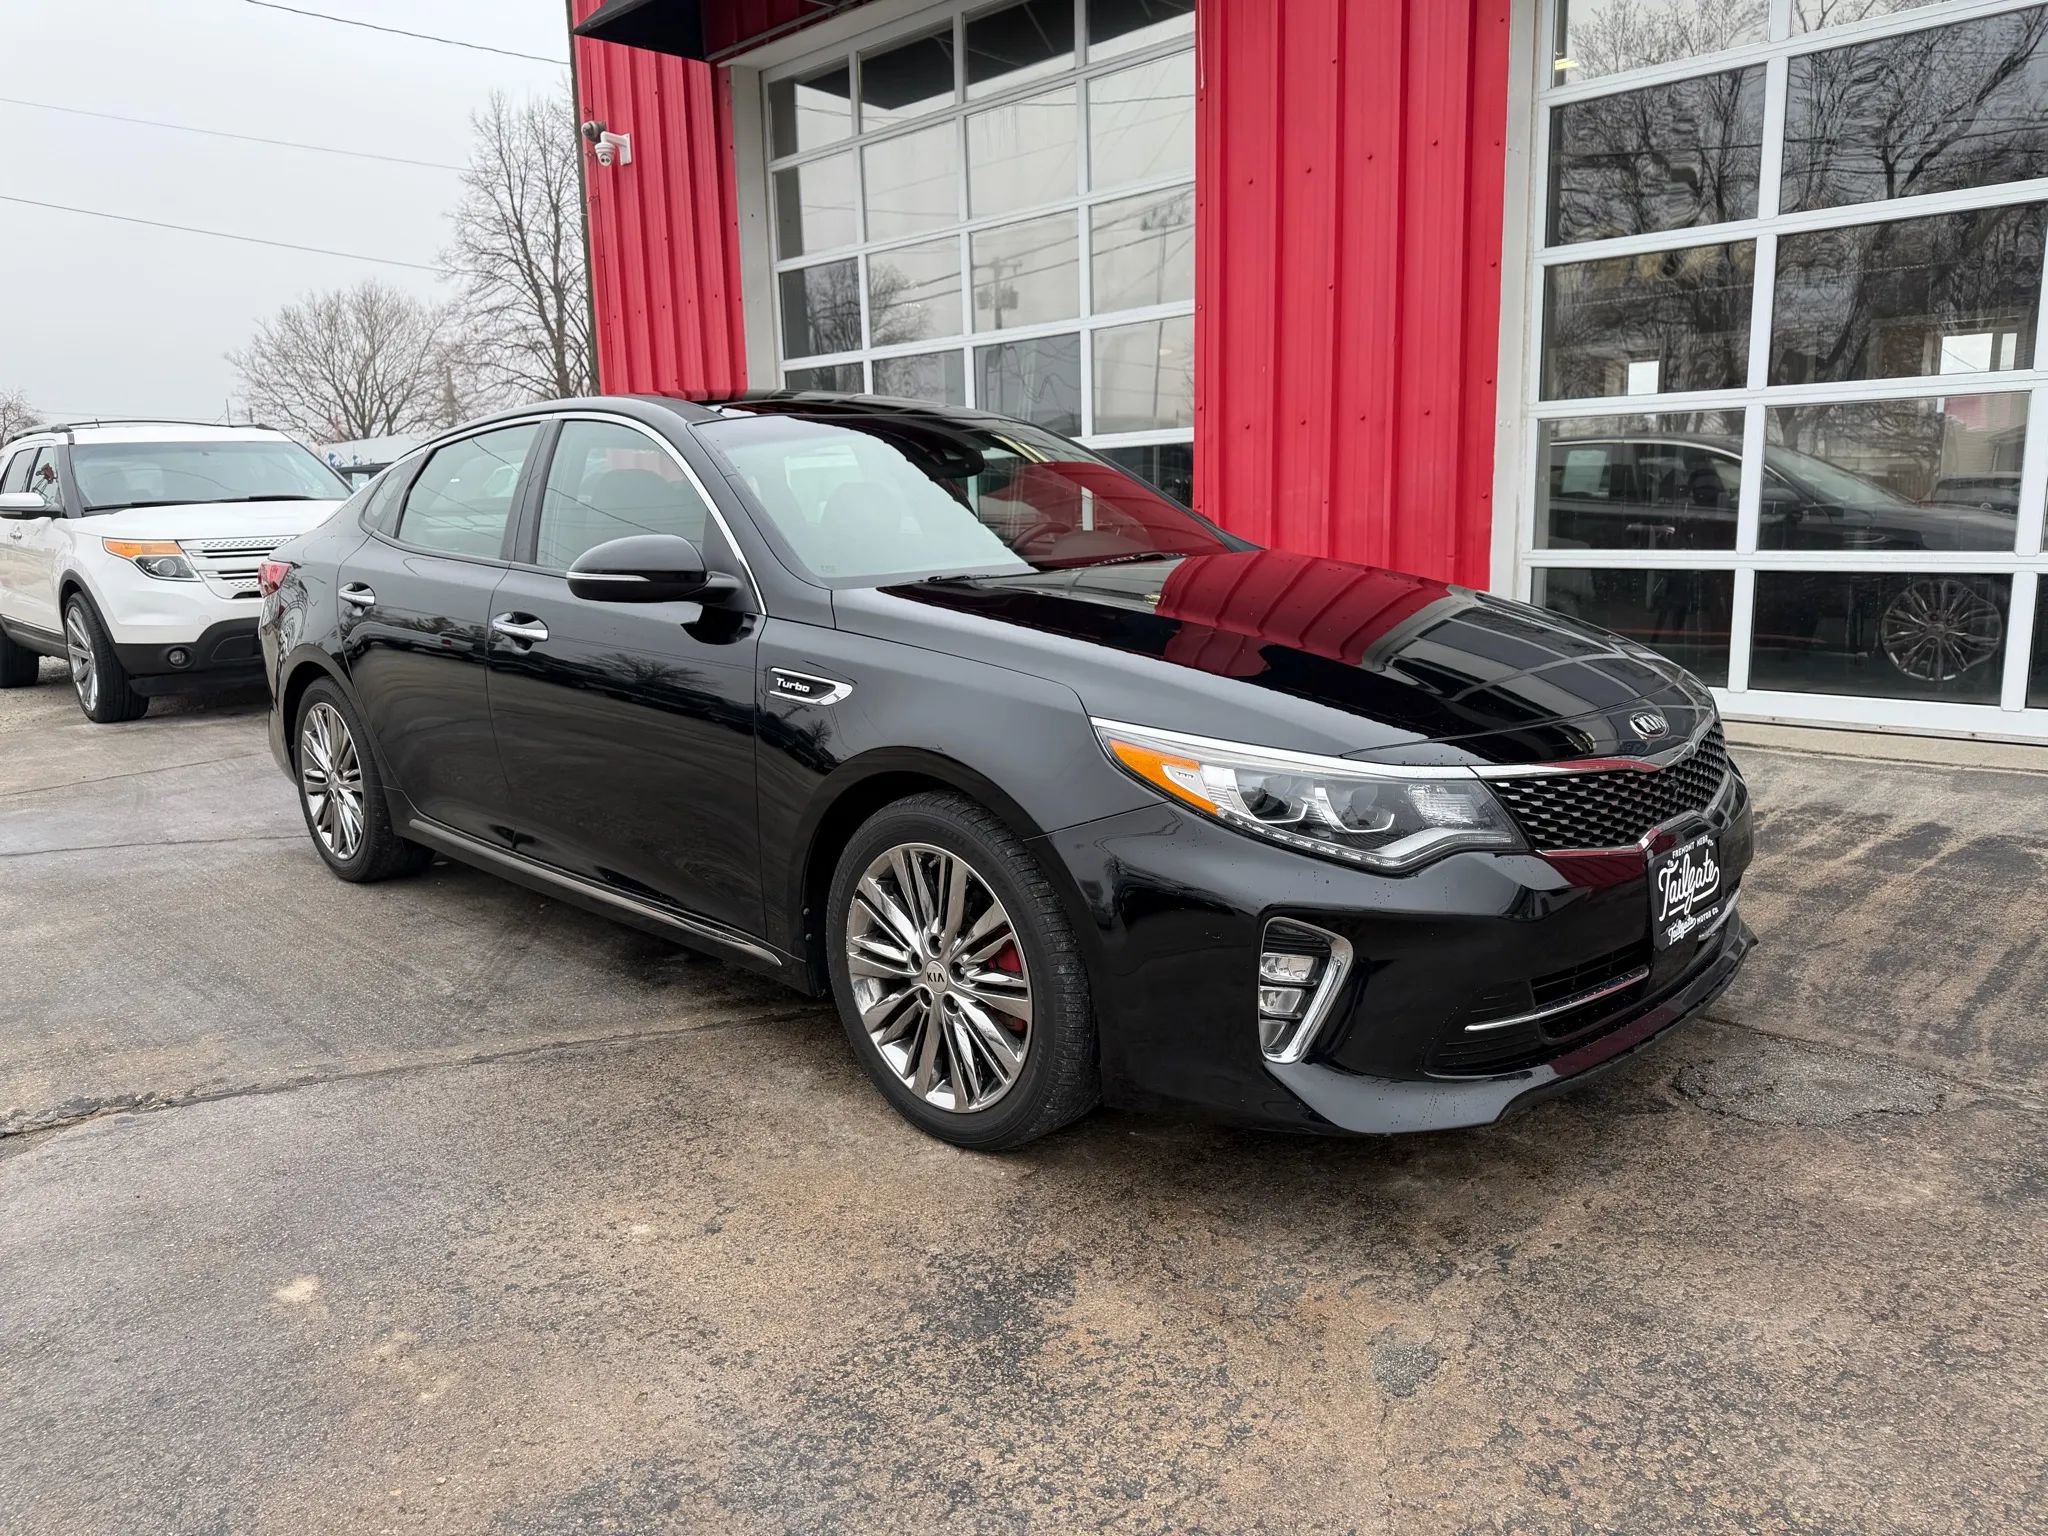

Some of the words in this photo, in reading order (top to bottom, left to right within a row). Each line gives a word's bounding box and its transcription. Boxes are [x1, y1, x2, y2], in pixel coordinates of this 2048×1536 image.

[776, 677, 811, 693] Turbo
[1635, 714, 1665, 733] KIA
[1672, 841, 1696, 859] FREMONT
[1658, 848, 1720, 922] Tailgate
[1668, 914, 1697, 945] Tailgate
[1696, 910, 1712, 925] MOTOR
[927, 972, 945, 983] KIA
